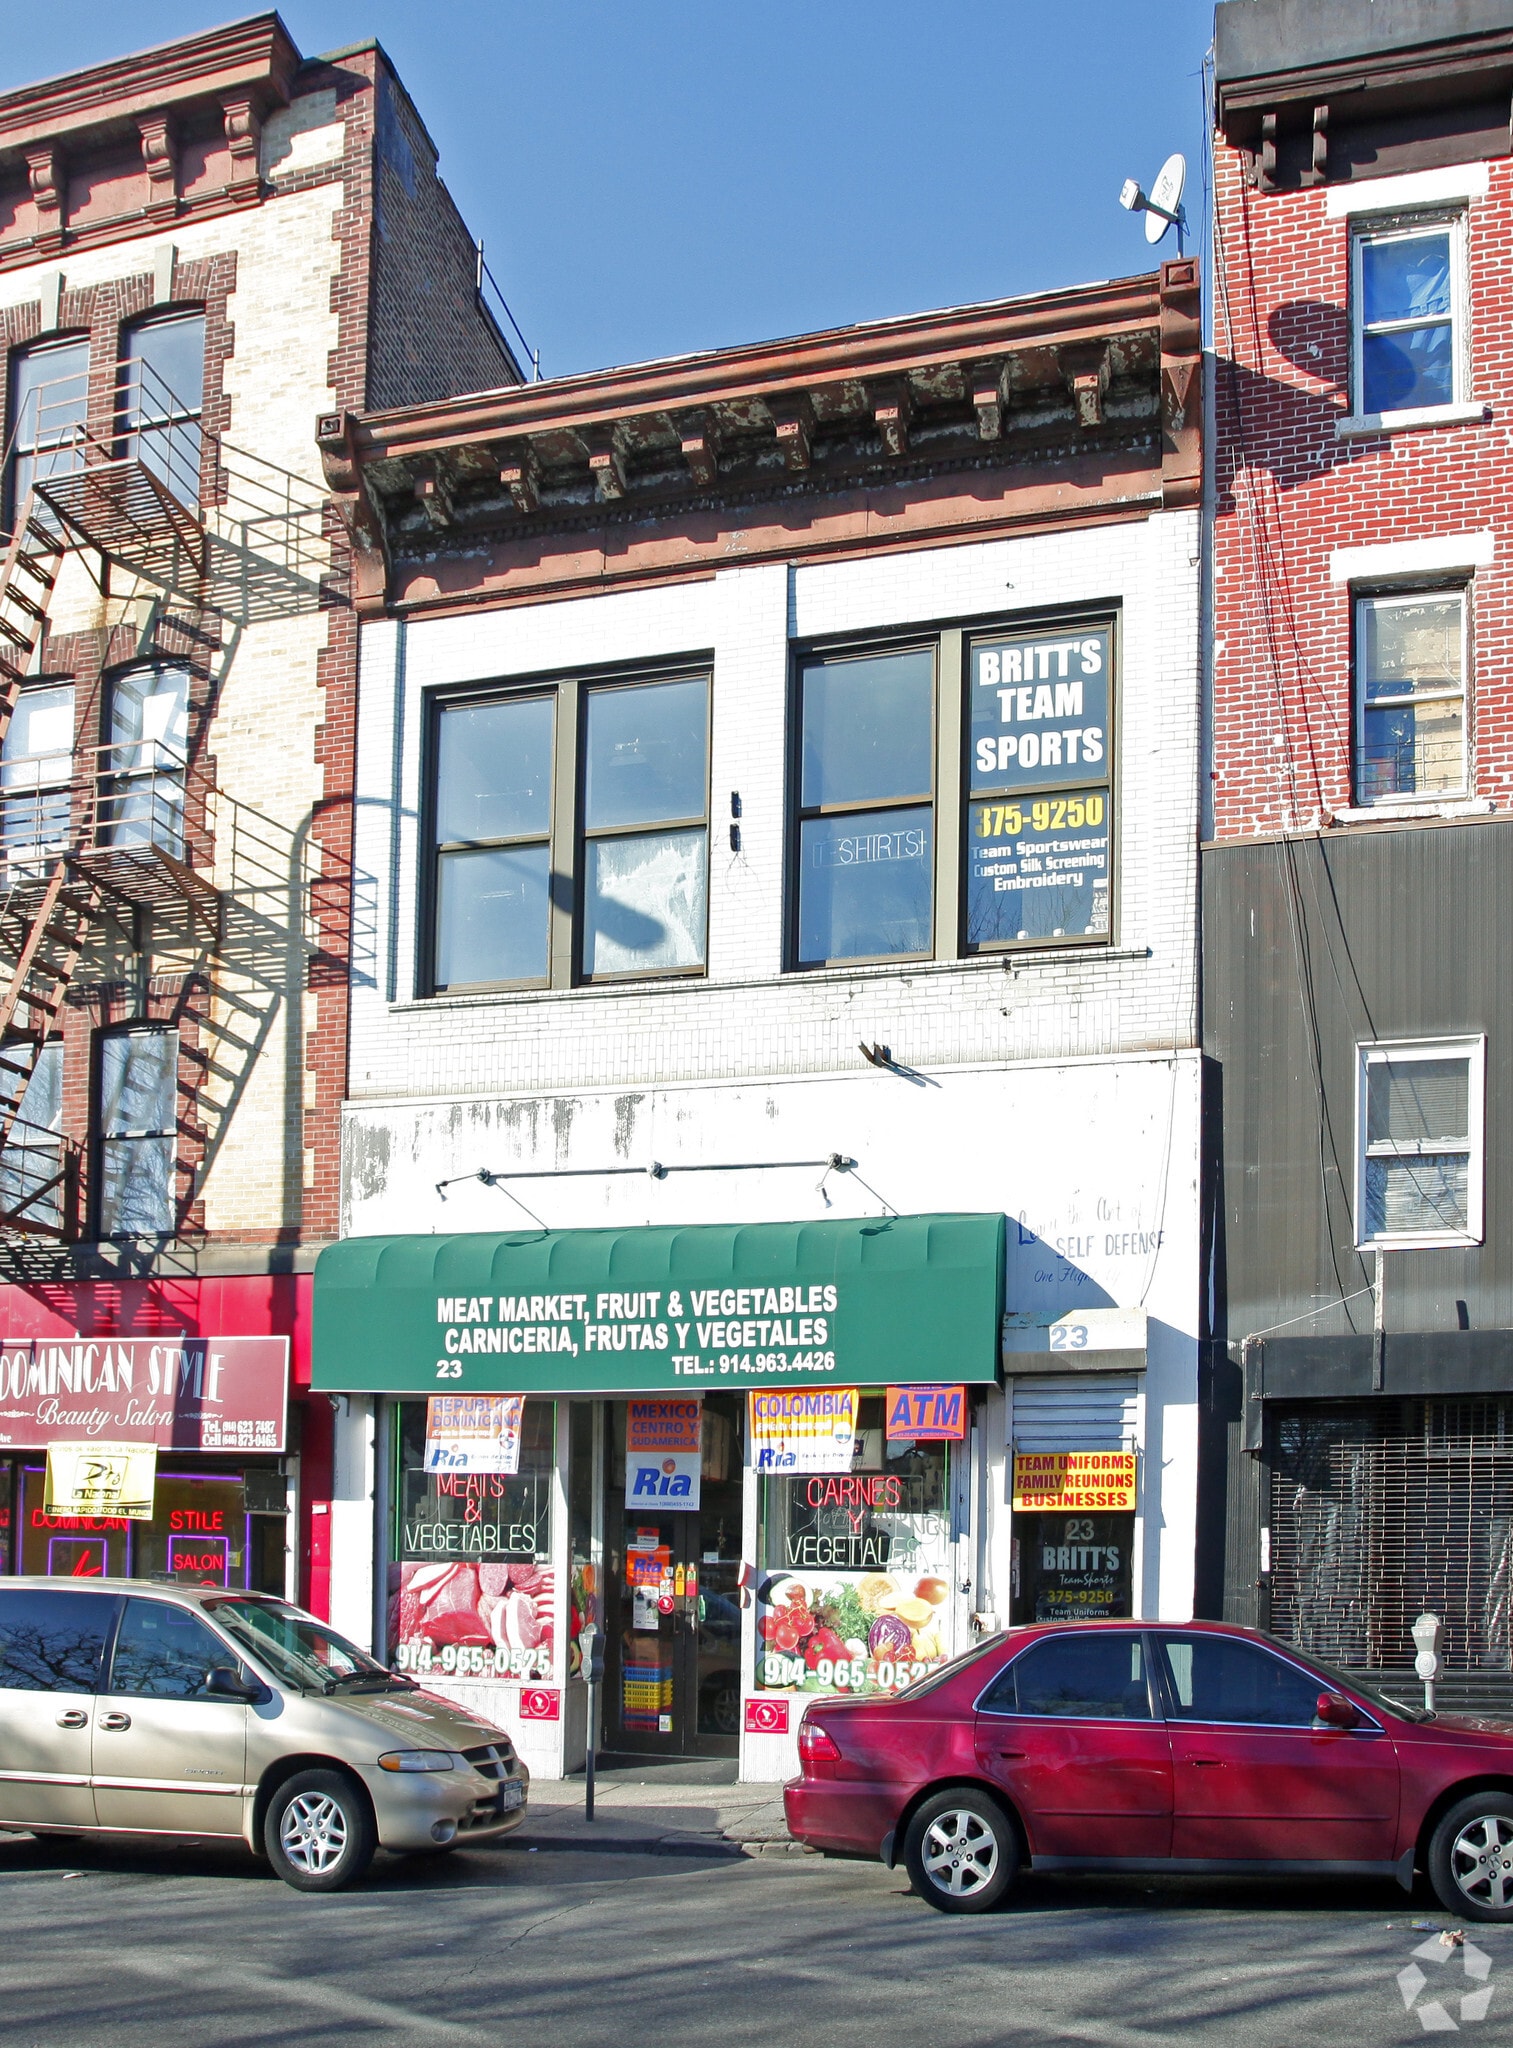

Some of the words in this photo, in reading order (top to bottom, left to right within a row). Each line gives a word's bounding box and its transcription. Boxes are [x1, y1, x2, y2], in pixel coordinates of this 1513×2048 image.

[978, 639, 1102, 686] BRITT'S
[997, 681, 1083, 723] TEAM
[976, 727, 1103, 772] SPORTS
[974, 796, 1103, 838] 375-9250
[971, 842, 1012, 859] Team
[1016, 837, 1109, 858] Sportswear
[973, 861, 1017, 877] Custom
[1020, 857, 1042, 872] Silk
[1045, 853, 1105, 873] Screening
[994, 871, 1083, 892] Embroidery
[1056, 1236, 1095, 1259] SELF
[1034, 1269, 1054, 1283] One
[1058, 1267, 1096, 1286] Fligh
[437, 1297, 493, 1323] MEAT
[498, 1294, 590, 1325] MARKET,
[596, 1291, 661, 1319] FRUIT
[667, 1290, 683, 1317] &
[690, 1285, 838, 1317] VEGETABLES
[444, 1326, 578, 1357] CARNICERIA,
[585, 1323, 669, 1351] FRUTAS
[674, 1322, 690, 1349] Y
[696, 1318, 828, 1348] VEGETALES
[1051, 1325, 1088, 1349] 23
[0, 1343, 134, 1401] DOMINICAN
[147, 1345, 226, 1403] STYLE
[436, 1360, 463, 1378] 23
[719, 1351, 835, 1374] 914.963.4426
[36, 1398, 112, 1435] Beauty
[114, 1399, 175, 1426] Salon
[632, 1404, 698, 1418] MEXICO
[755, 1393, 852, 1418] COLOMBIA
[889, 1393, 962, 1427] ATM
[237, 1420, 254, 1434] 623
[432, 1415, 521, 1427] DOMINICANA
[632, 1422, 684, 1434] CENTRO
[688, 1422, 697, 1433] Y
[202, 1433, 221, 1446] Cell
[631, 1436, 697, 1446] SUDAMERICA
[758, 1446, 797, 1467] Ria
[1017, 1457, 1055, 1471] TEAM
[1058, 1455, 1134, 1470] UNIFORMS
[437, 1473, 505, 1498] MEATS
[632, 1462, 692, 1497] Ria
[807, 1476, 902, 1506] CARNES
[1017, 1474, 1063, 1489] FAMILY
[1065, 1474, 1133, 1488] REUNIONS
[464, 1498, 482, 1523] &
[1022, 1492, 1128, 1507] BUSINESSES
[32, 1509, 129, 1532] DOMINICAN
[170, 1511, 224, 1530] STILE
[847, 1509, 866, 1534] Y
[1067, 1519, 1095, 1540] 23
[405, 1523, 535, 1551] VEGETABLES
[173, 1553, 224, 1570] SALON
[1042, 1546, 1120, 1571] BRITT'S
[1047, 1590, 1114, 1604] 375-9250
[1050, 1608, 1071, 1616] Team
[1073, 1607, 1110, 1616] Uniforms
[396, 1644, 551, 1675] 914-965-0525
[764, 1658, 941, 1688] 914-965-052
